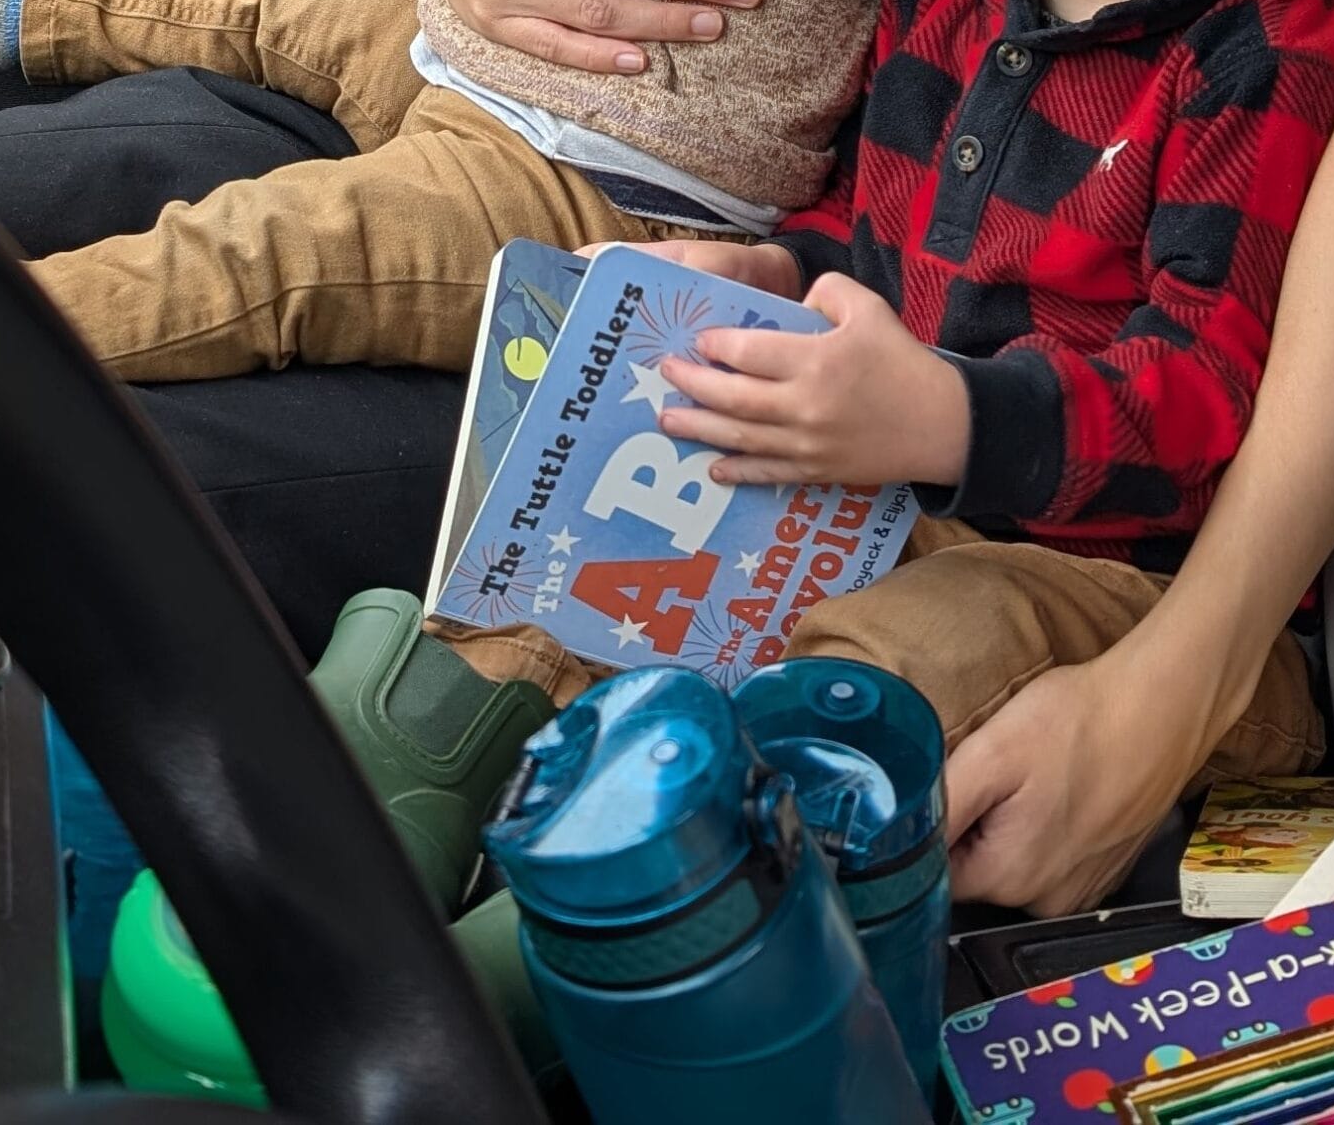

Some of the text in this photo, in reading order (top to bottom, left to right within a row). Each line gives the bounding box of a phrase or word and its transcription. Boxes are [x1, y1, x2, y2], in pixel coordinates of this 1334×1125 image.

[478, 282, 645, 597] The Tuttle Toddlers
[533, 550, 566, 615] The
[715, 628, 745, 665] The
[985, 1012, 1129, 1073] Words
